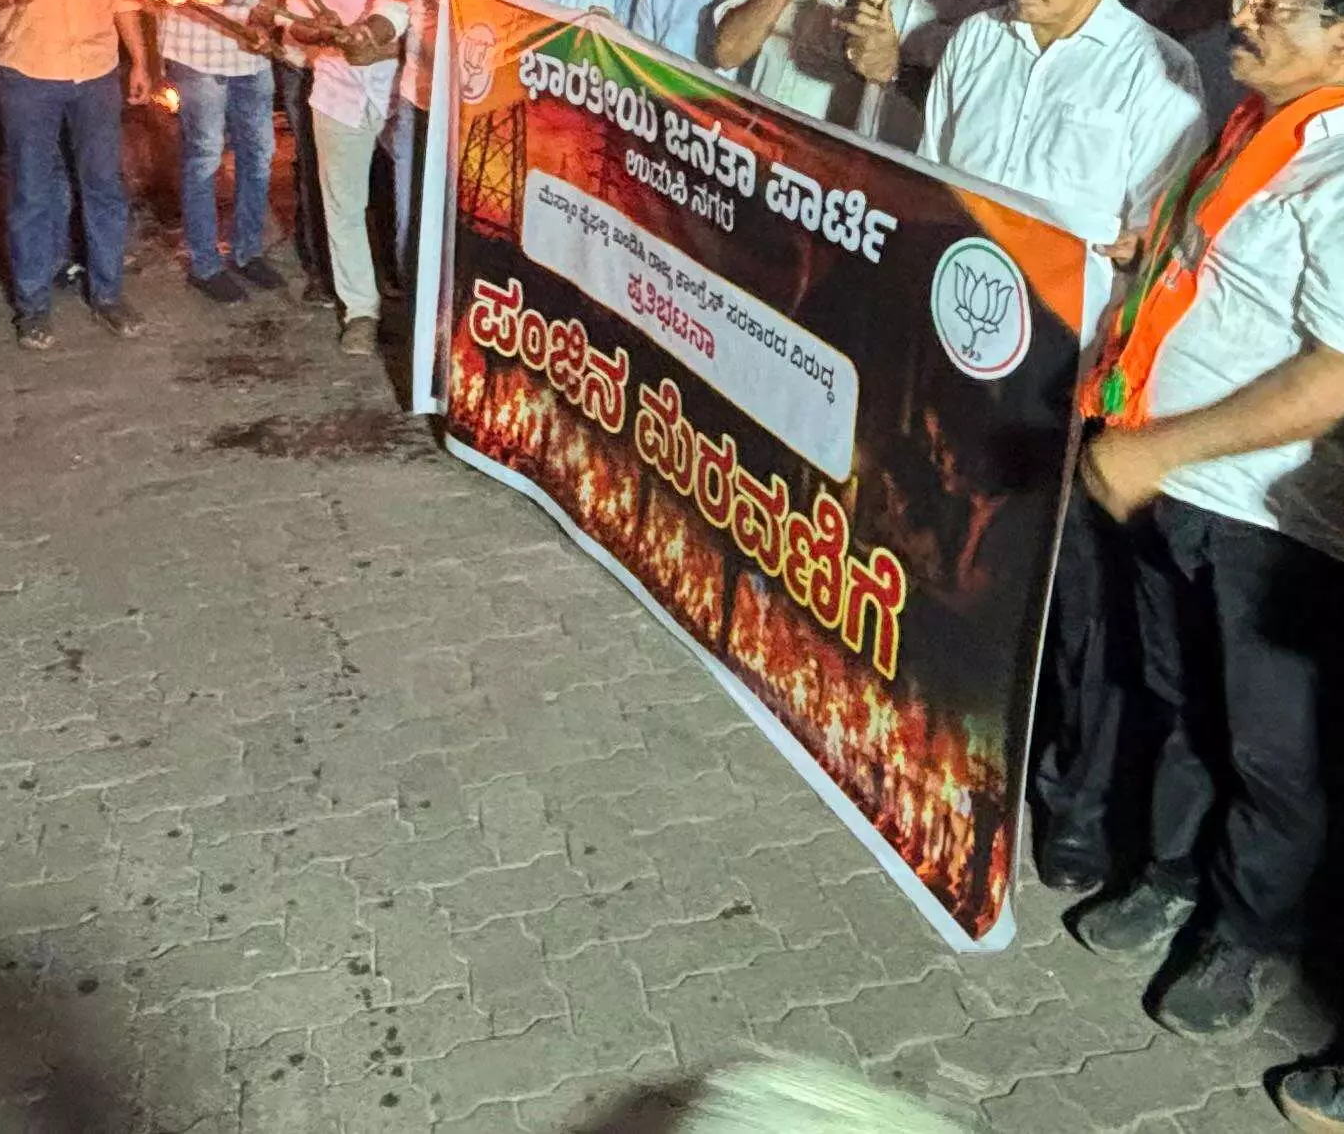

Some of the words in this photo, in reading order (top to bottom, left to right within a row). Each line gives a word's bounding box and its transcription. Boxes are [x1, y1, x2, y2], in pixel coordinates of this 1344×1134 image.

[518, 49, 658, 144] ಭಾರತೀಯ
[663, 109, 756, 198] ಜನತಾ
[764, 161, 898, 264] ಪಾರ್ಟಿ
[625, 148, 688, 206] ಉಡುಪಿ
[690, 182, 734, 234] ನಗರ
[627, 272, 716, 360] ಪ್ರತಿಭಟನಾ
[726, 302, 787, 358] ಸರಕಾರದ
[469, 277, 629, 434] ಪಂಜಿನ
[635, 378, 906, 681] ಮೆರವಣಿಗೆ
